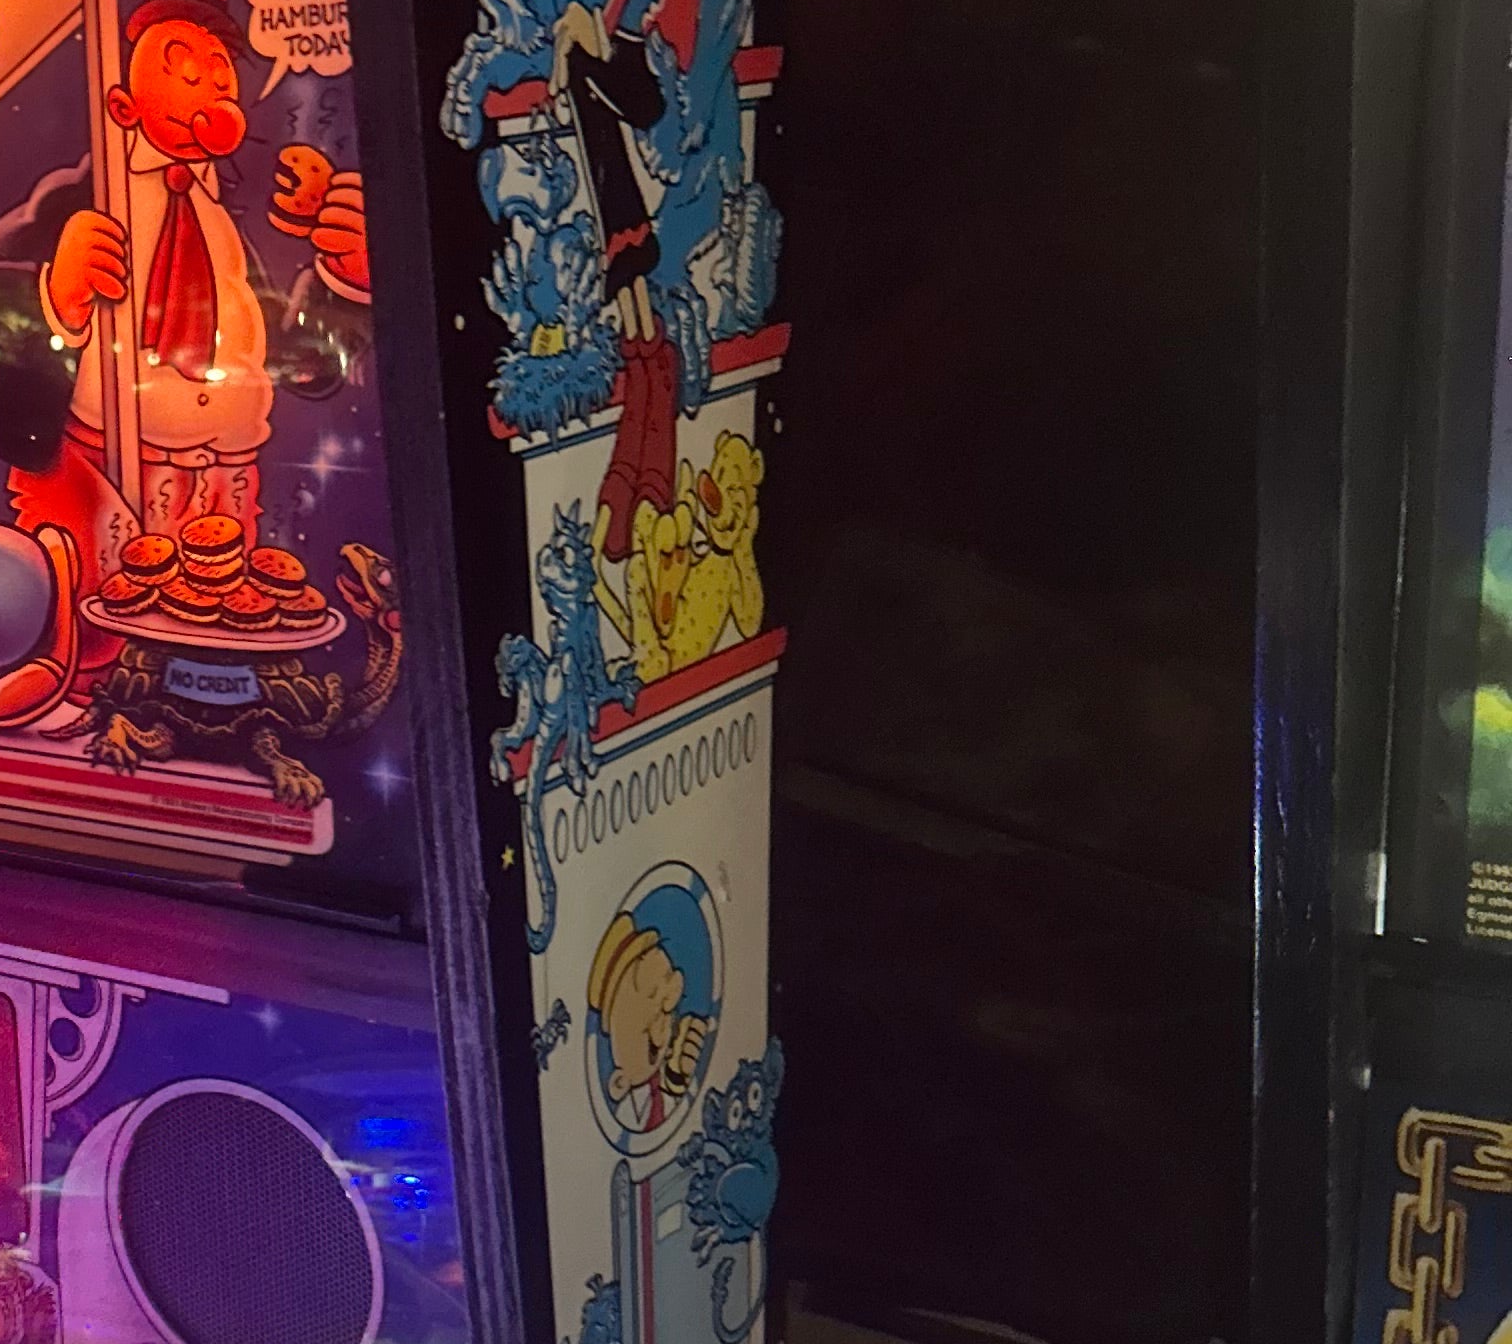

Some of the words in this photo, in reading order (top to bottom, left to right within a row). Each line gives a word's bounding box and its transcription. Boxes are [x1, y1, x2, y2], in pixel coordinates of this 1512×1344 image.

[170, 669, 193, 688] NO
[197, 674, 250, 694] CREDIT
[1468, 877, 1512, 893] JUDG
